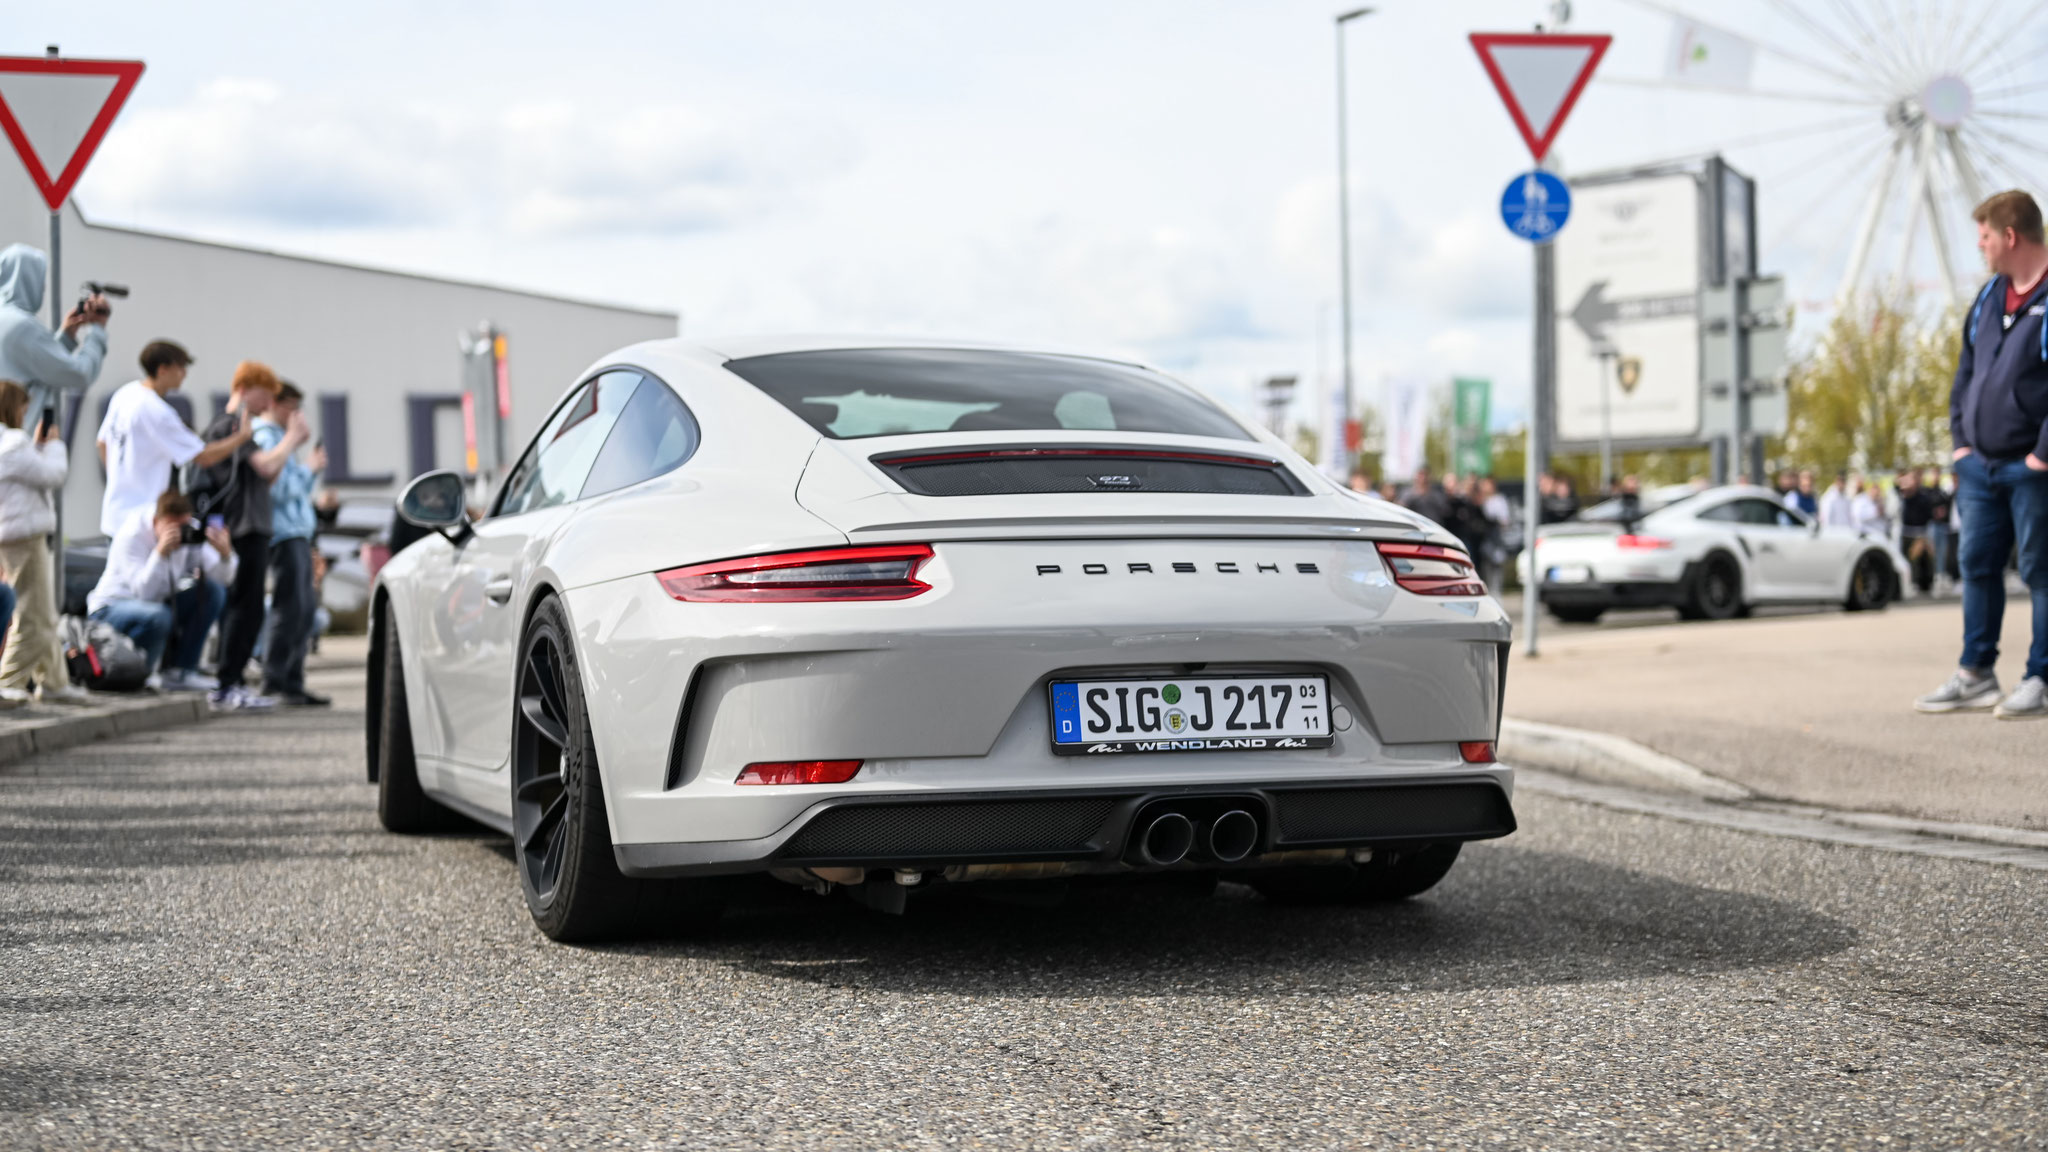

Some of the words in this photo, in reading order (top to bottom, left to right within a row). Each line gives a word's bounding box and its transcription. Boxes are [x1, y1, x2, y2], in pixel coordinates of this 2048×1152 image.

[1036, 562, 1320, 576] PORSCHE
[1299, 685, 1317, 698] 03
[1086, 687, 1161, 733] SIG
[1190, 686, 1214, 731] J
[1223, 685, 1292, 730] 217
[1062, 720, 1073, 733] D
[1303, 716, 1319, 729] 11
[1135, 739, 1267, 751] WENDLAND
